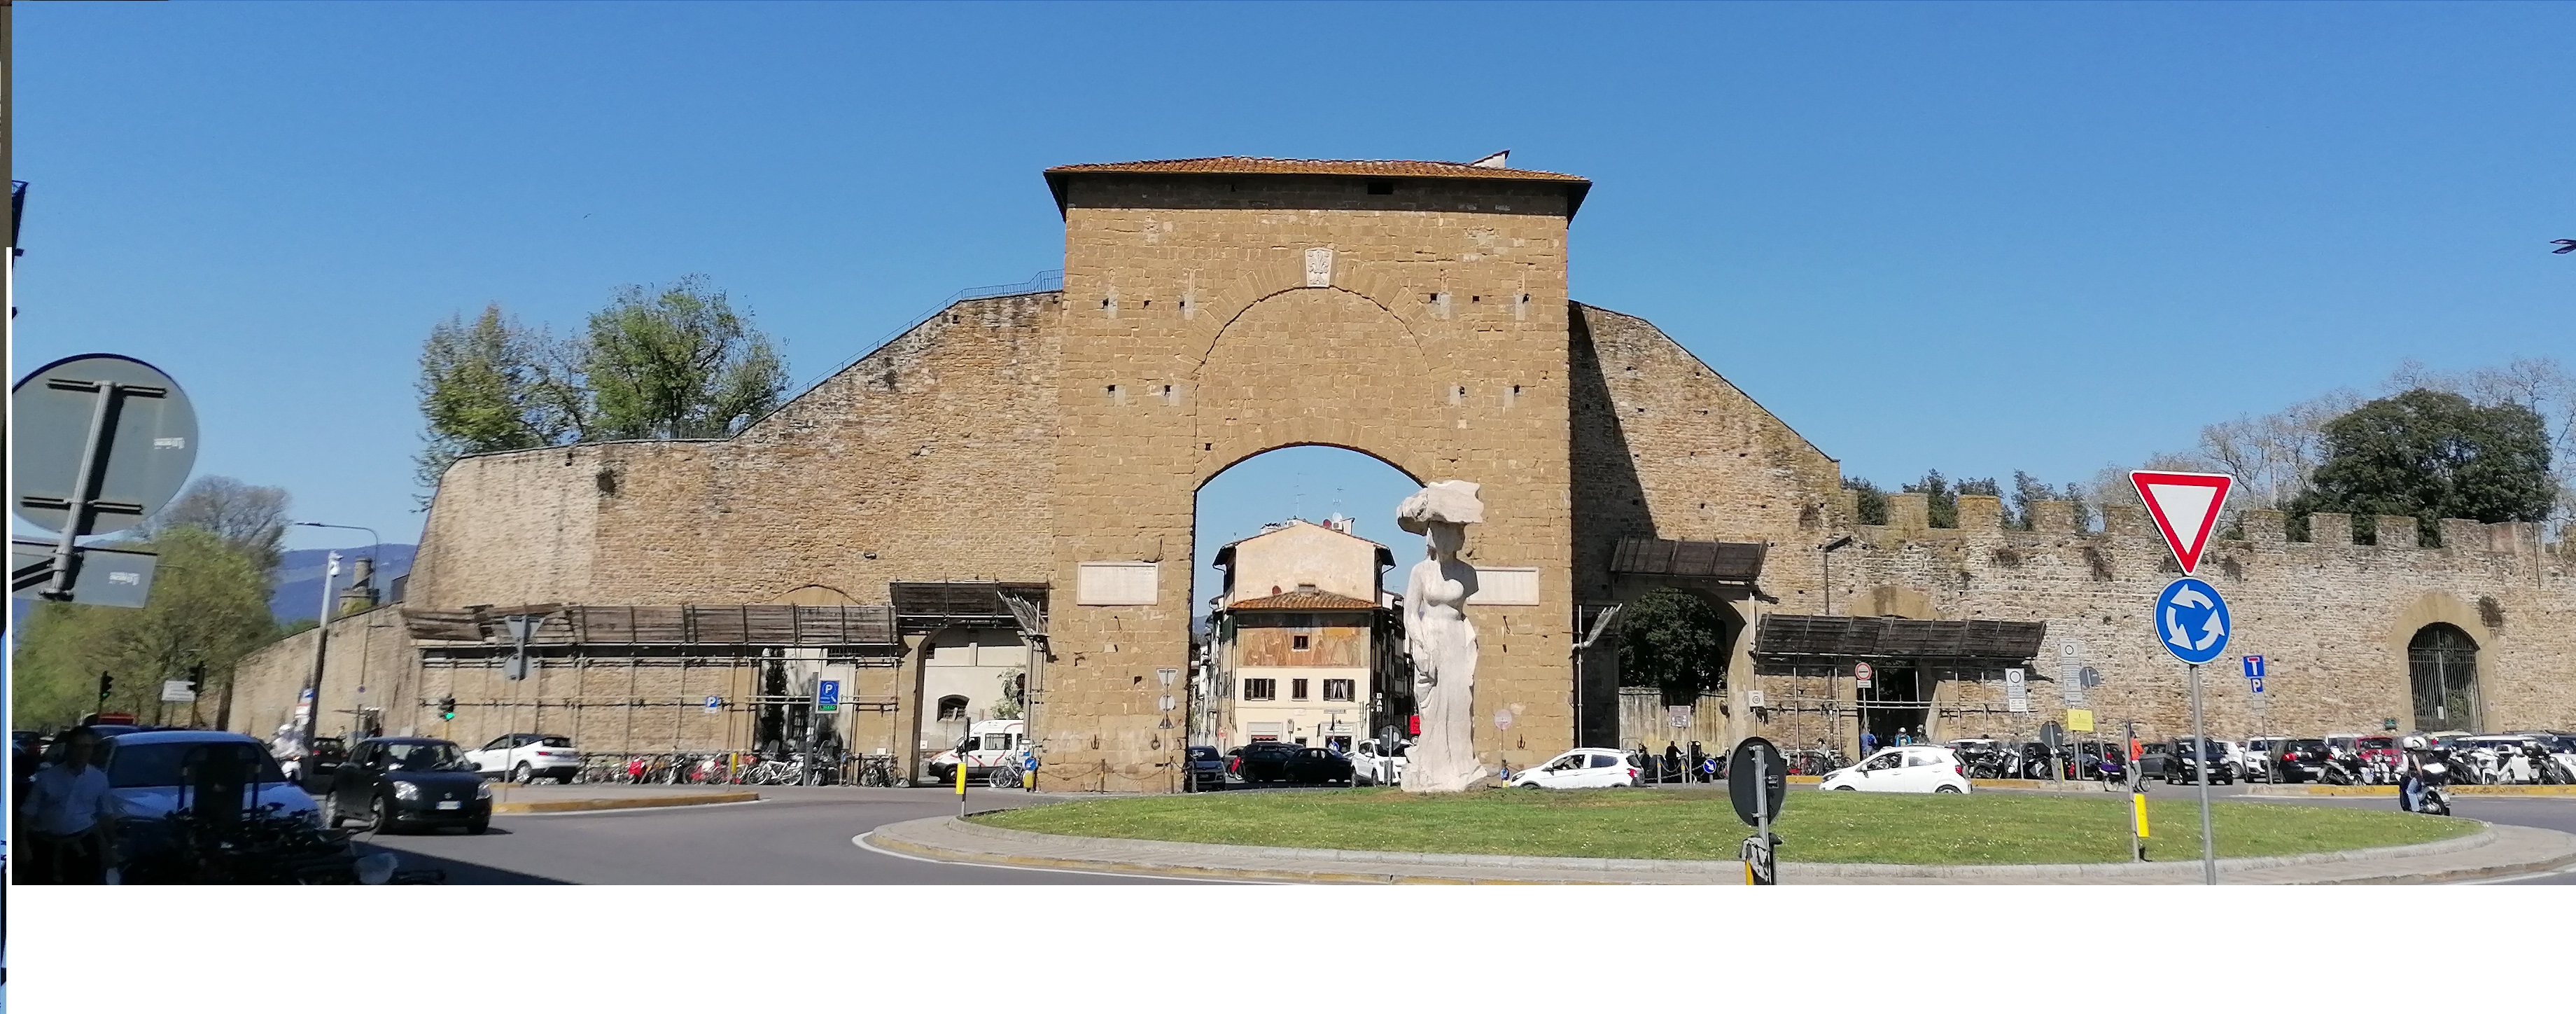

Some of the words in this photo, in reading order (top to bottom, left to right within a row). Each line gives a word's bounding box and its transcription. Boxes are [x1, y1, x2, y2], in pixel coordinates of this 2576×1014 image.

[825, 684, 833, 693] P
[2252, 679, 2261, 693] P
[707, 696, 716, 707] P
